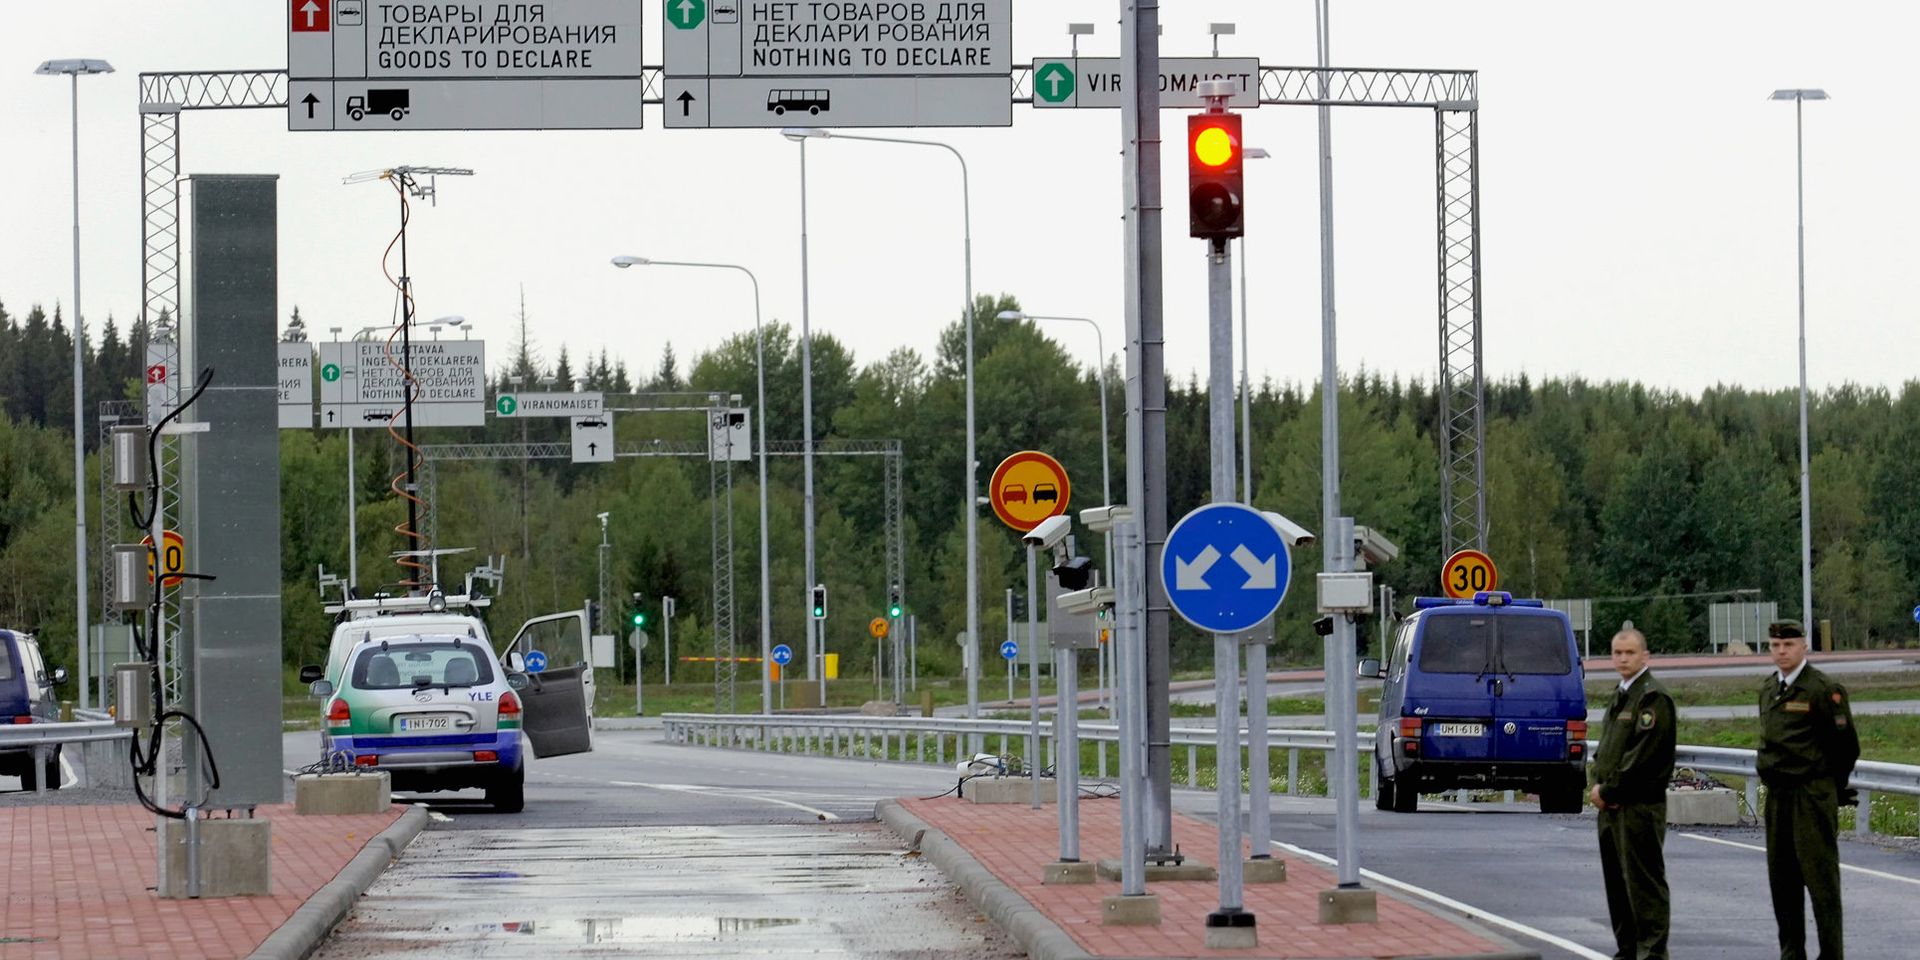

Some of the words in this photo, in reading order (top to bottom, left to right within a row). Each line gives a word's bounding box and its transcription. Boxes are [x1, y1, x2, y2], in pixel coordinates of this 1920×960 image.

[379, 4, 482, 24] ТОВАРЫ
[494, 4, 545, 26] ДЛЯ
[753, 3, 799, 22] НЕТ
[808, 3, 926, 22] ТОВАРОВ
[936, 2, 986, 24] ДЛЯ
[379, 25, 617, 49] ДЕКЛАРИРОВАНИЯ
[753, 24, 869, 47] ДЕКЛАРИ
[878, 23, 990, 42] РОВАНИЯ
[379, 50, 451, 69] GOODS
[462, 50, 487, 68] TO
[497, 49, 592, 68] DECLARE
[753, 48, 851, 67] NOTHING
[861, 48, 887, 66] TO
[897, 47, 991, 66] DECLARE
[362, 345, 372, 355] EI
[397, 356, 415, 366] AT
[420, 355, 479, 366] DEKLARERA
[361, 368, 384, 378] НЕТ
[389, 367, 444, 377] ТОАРОВ
[449, 366, 473, 378] ДЛЯ
[362, 377, 475, 389] ДЕКЛАРОВАНИЯ
[430, 388, 476, 399] DECLARE
[521, 399, 599, 410] VIRANOMAISET
[1453, 565, 1486, 592] 30
[468, 692, 493, 701] YLE
[409, 718, 447, 729] INI-702
[1441, 724, 1480, 734] UMI-618
